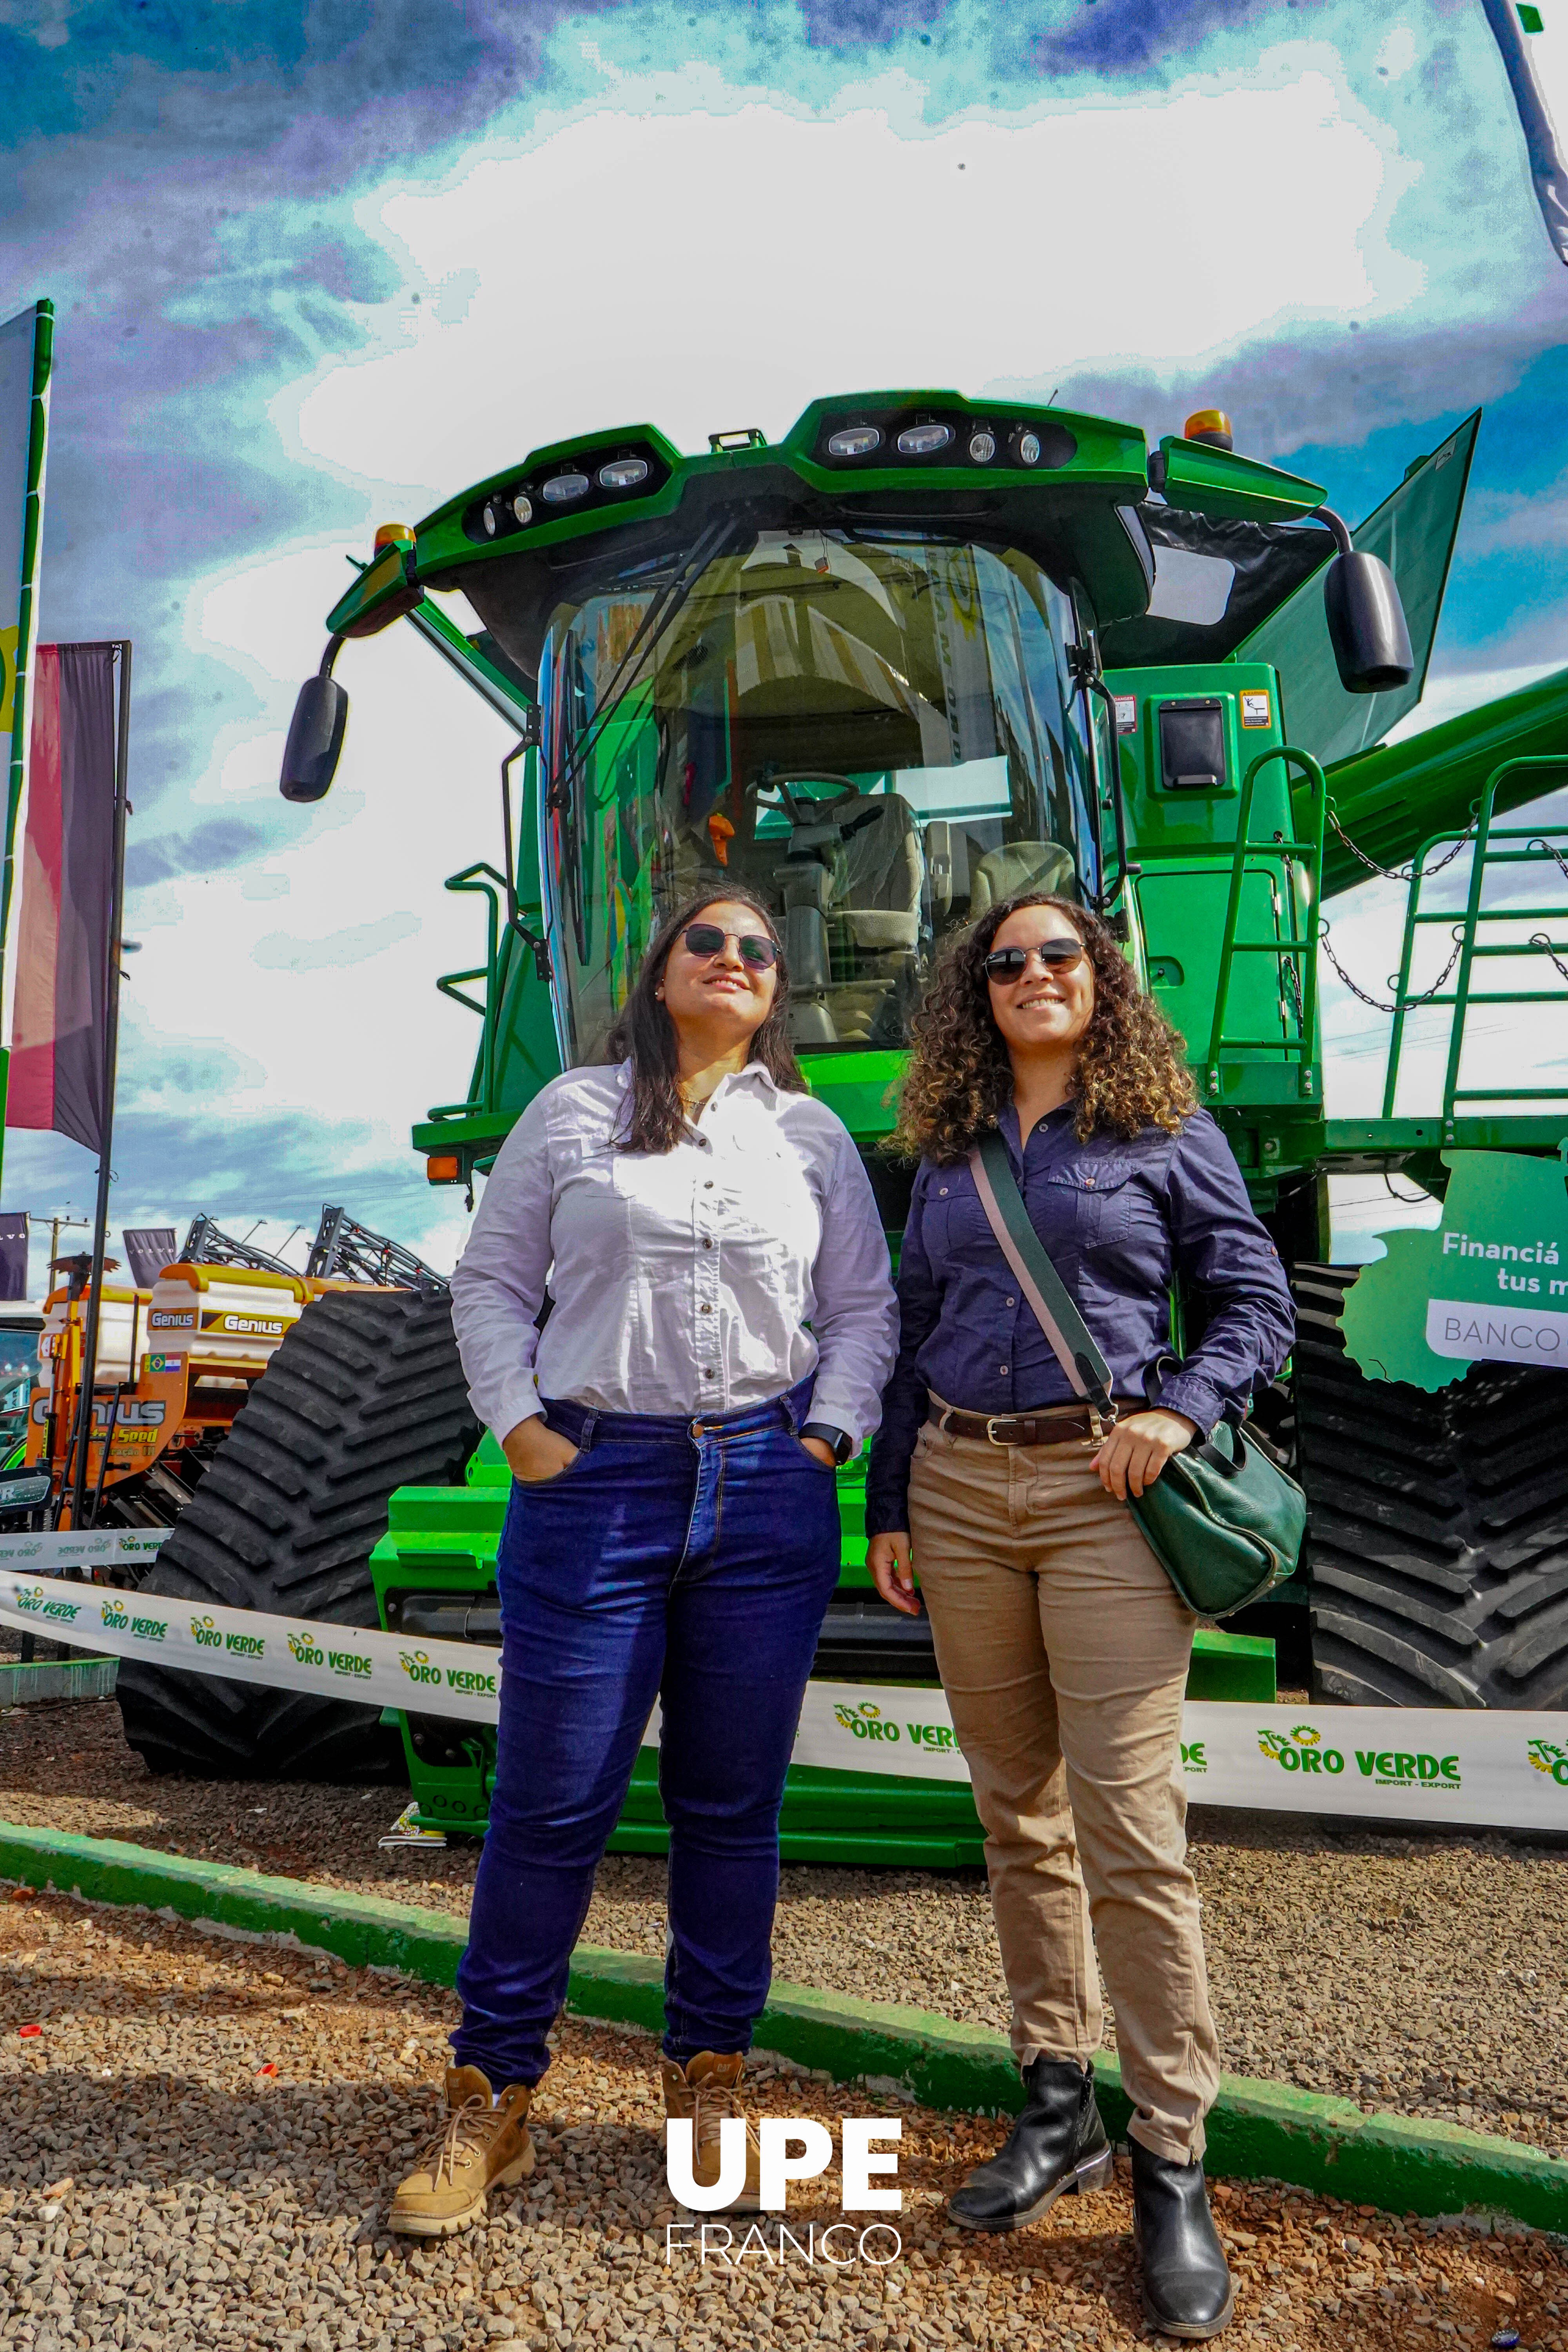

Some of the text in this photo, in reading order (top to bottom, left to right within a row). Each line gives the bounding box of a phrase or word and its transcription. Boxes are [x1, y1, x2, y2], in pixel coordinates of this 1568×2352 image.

[1443, 1232, 1559, 1265] Financiá
[1497, 1268, 1540, 1293] tus
[1445, 1318, 1560, 1351] BANCO
[118, 1428, 158, 1443] Seed
[18, 1597, 82, 1619] ORO VERDE
[103, 1613, 168, 1638] ORO VERDE
[196, 1629, 265, 1655] ORO VERDE
[296, 1646, 372, 1675] ORO VERDE
[410, 1664, 496, 1693] ORO VERDE
[851, 1719, 900, 1741] ORO
[1280, 1748, 1461, 1781] ORO VERDE
[1375, 1779, 1413, 1787] IMPORT
